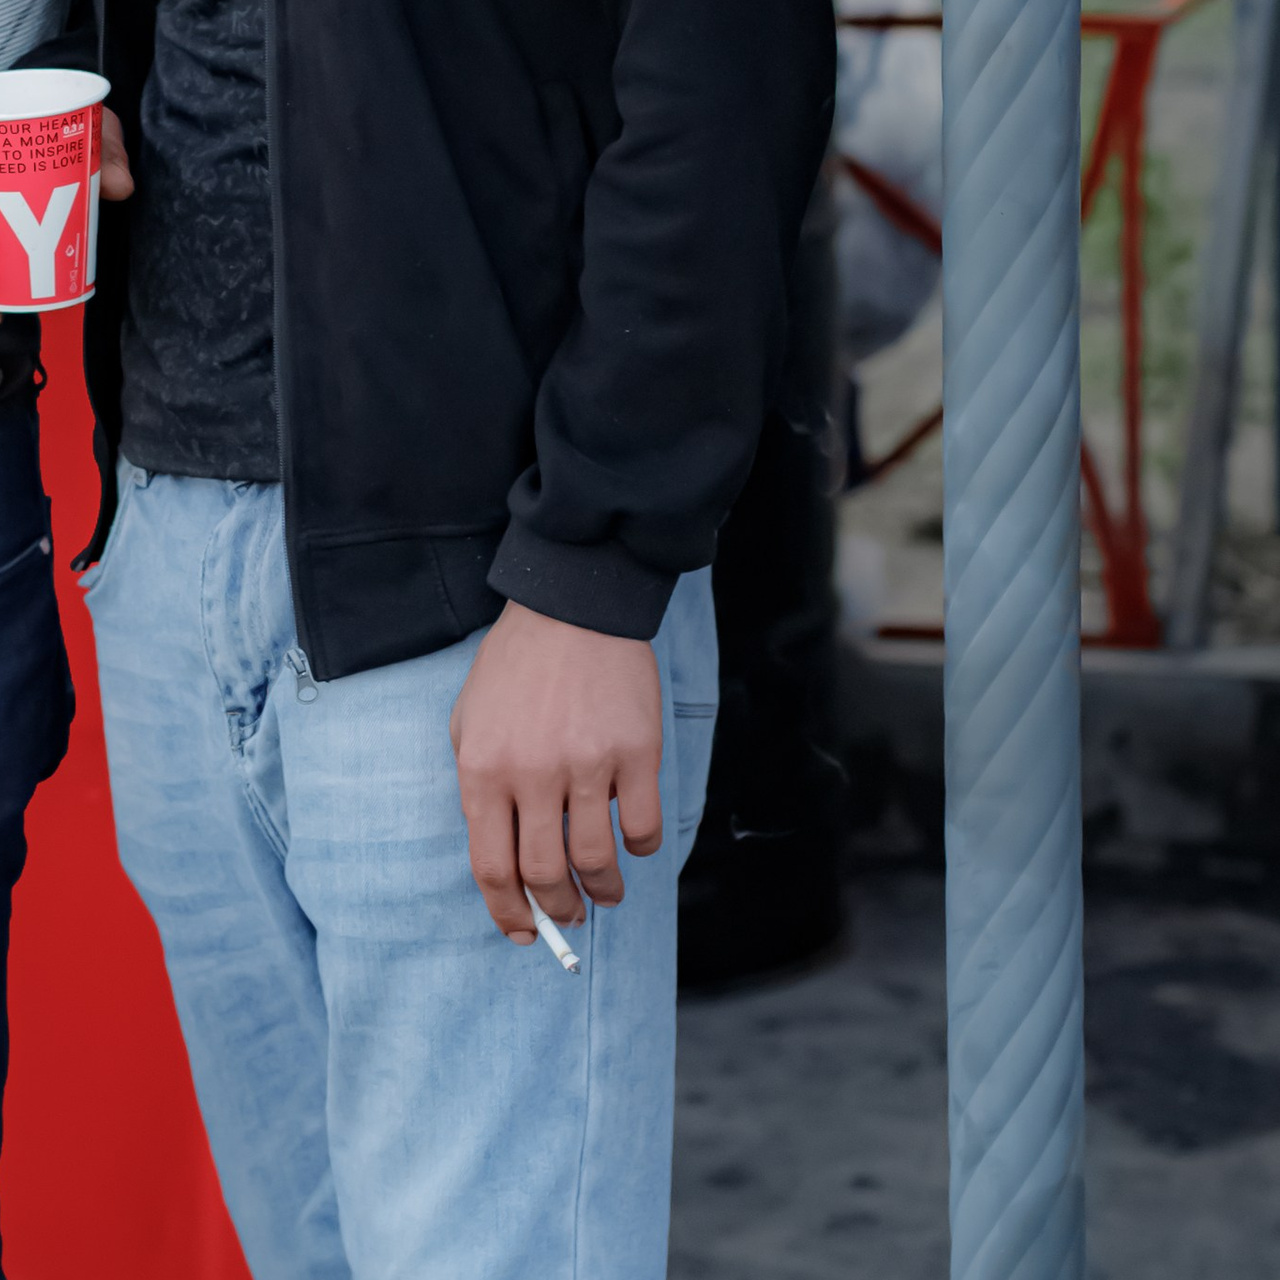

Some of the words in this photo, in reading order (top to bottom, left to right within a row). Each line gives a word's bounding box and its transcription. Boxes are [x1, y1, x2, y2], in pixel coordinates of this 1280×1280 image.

[39, 112, 85, 132] HEART
[2, 137, 13, 148] A
[20, 132, 59, 148] MOM
[2, 149, 22, 161] TO
[29, 138, 84, 160] INSPIRE
[33, 161, 47, 173] IS
[52, 152, 84, 170] LOVE
